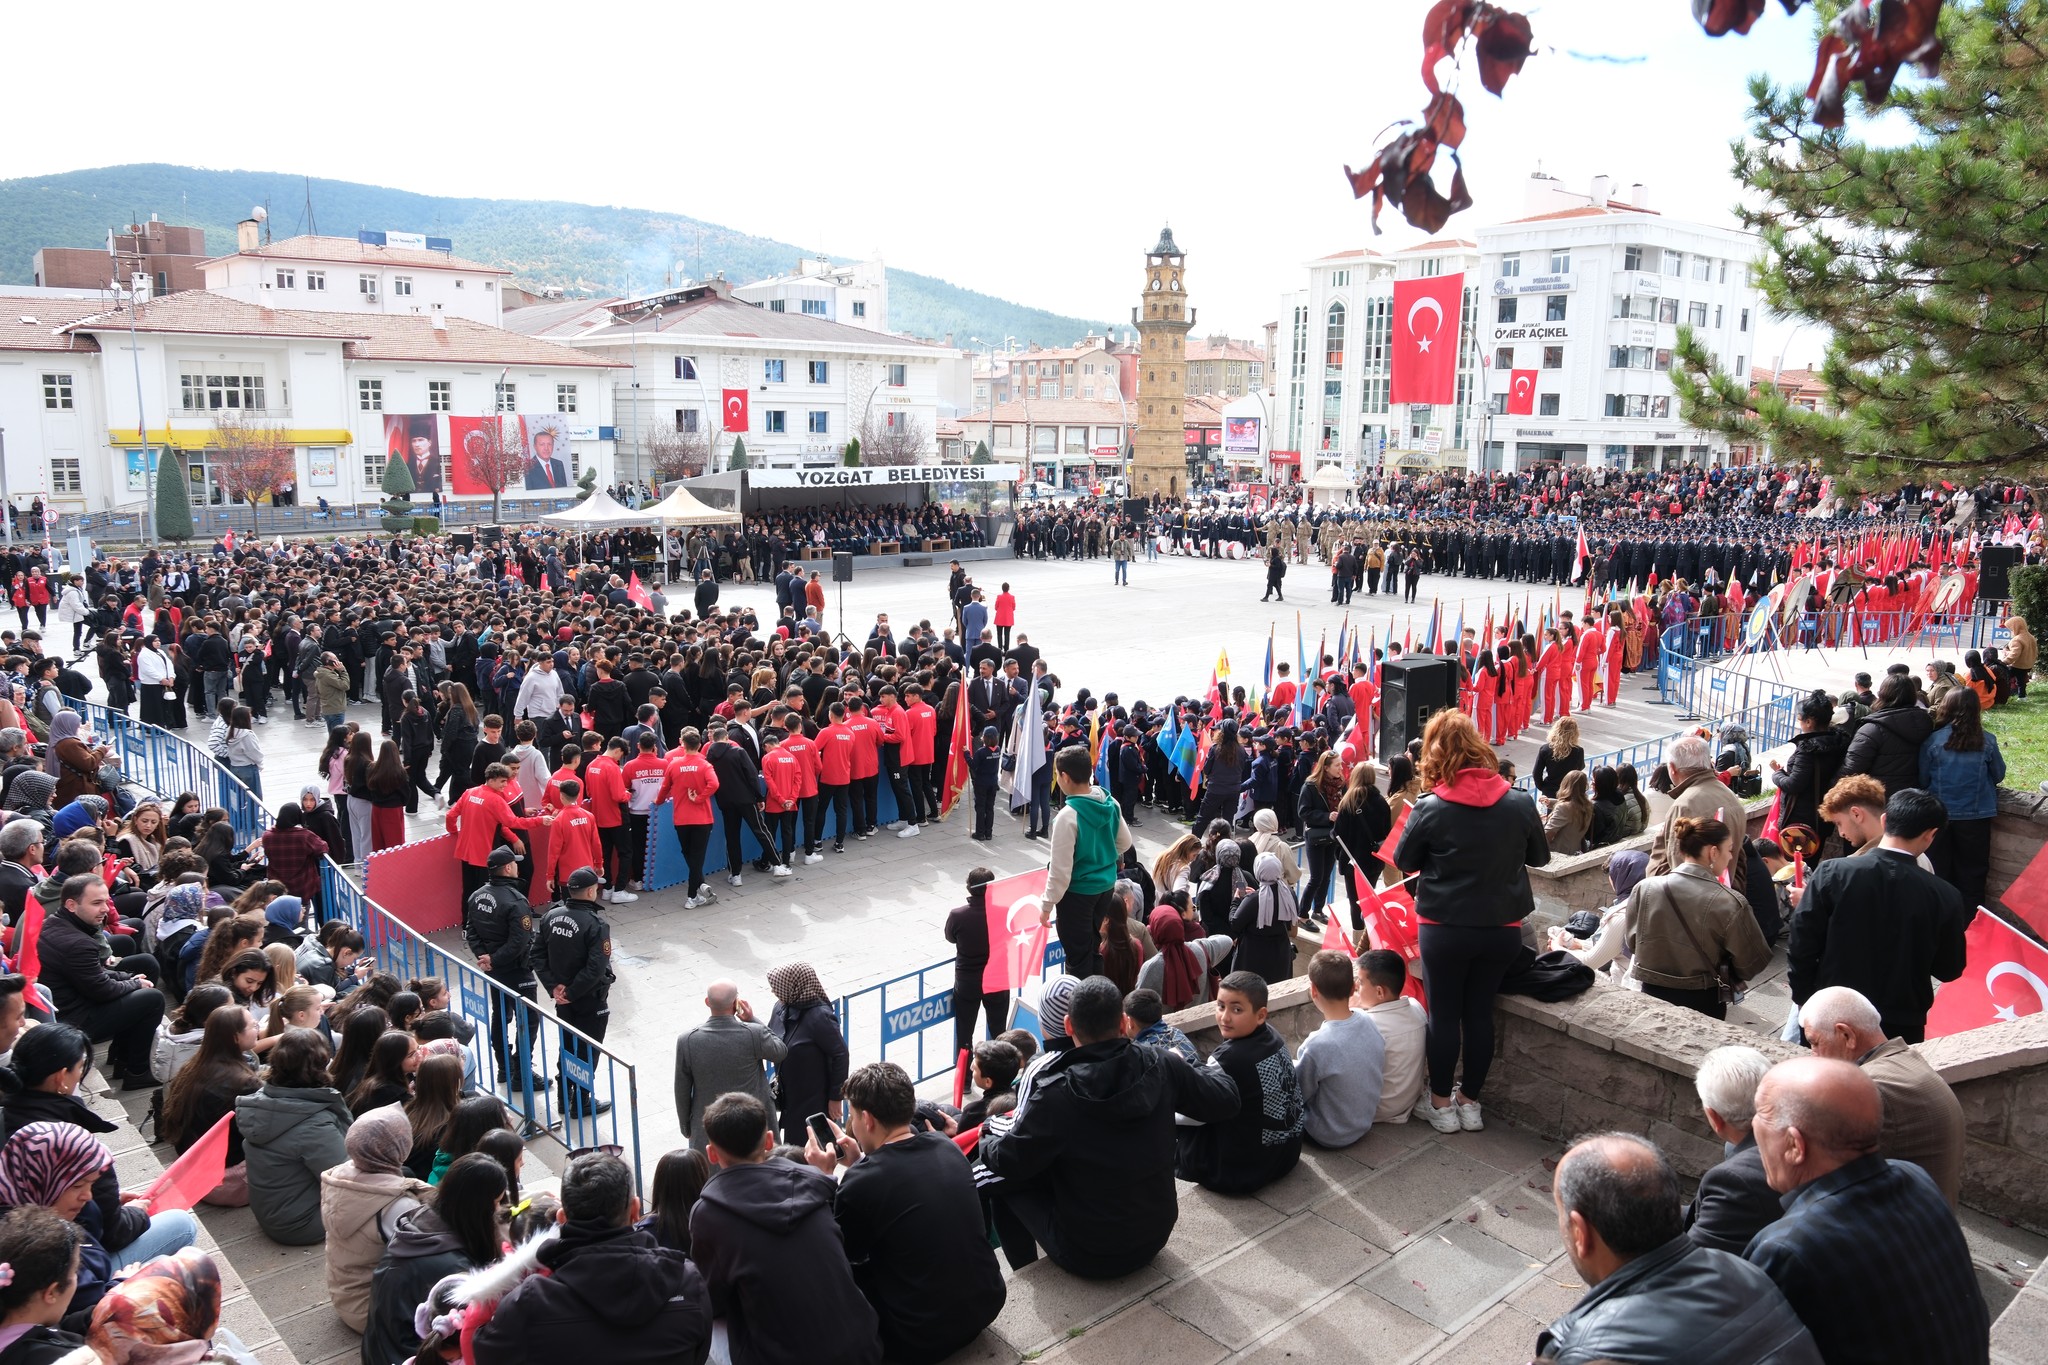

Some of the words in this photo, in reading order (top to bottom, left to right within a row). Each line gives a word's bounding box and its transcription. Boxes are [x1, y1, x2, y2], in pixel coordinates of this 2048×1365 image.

[1494, 328, 1526, 340] ÖMER
[1529, 328, 1568, 340] AÇIKEL
[796, 470, 873, 485] YOZGAT
[469, 796, 484, 805] YOZGAT
[570, 818, 588, 826] YOZGAT
[564, 916, 579, 933] KUVVET
[1048, 947, 1066, 962] POL
[888, 993, 955, 1034] YOZGAT
[565, 1058, 589, 1084] YOZGAT
